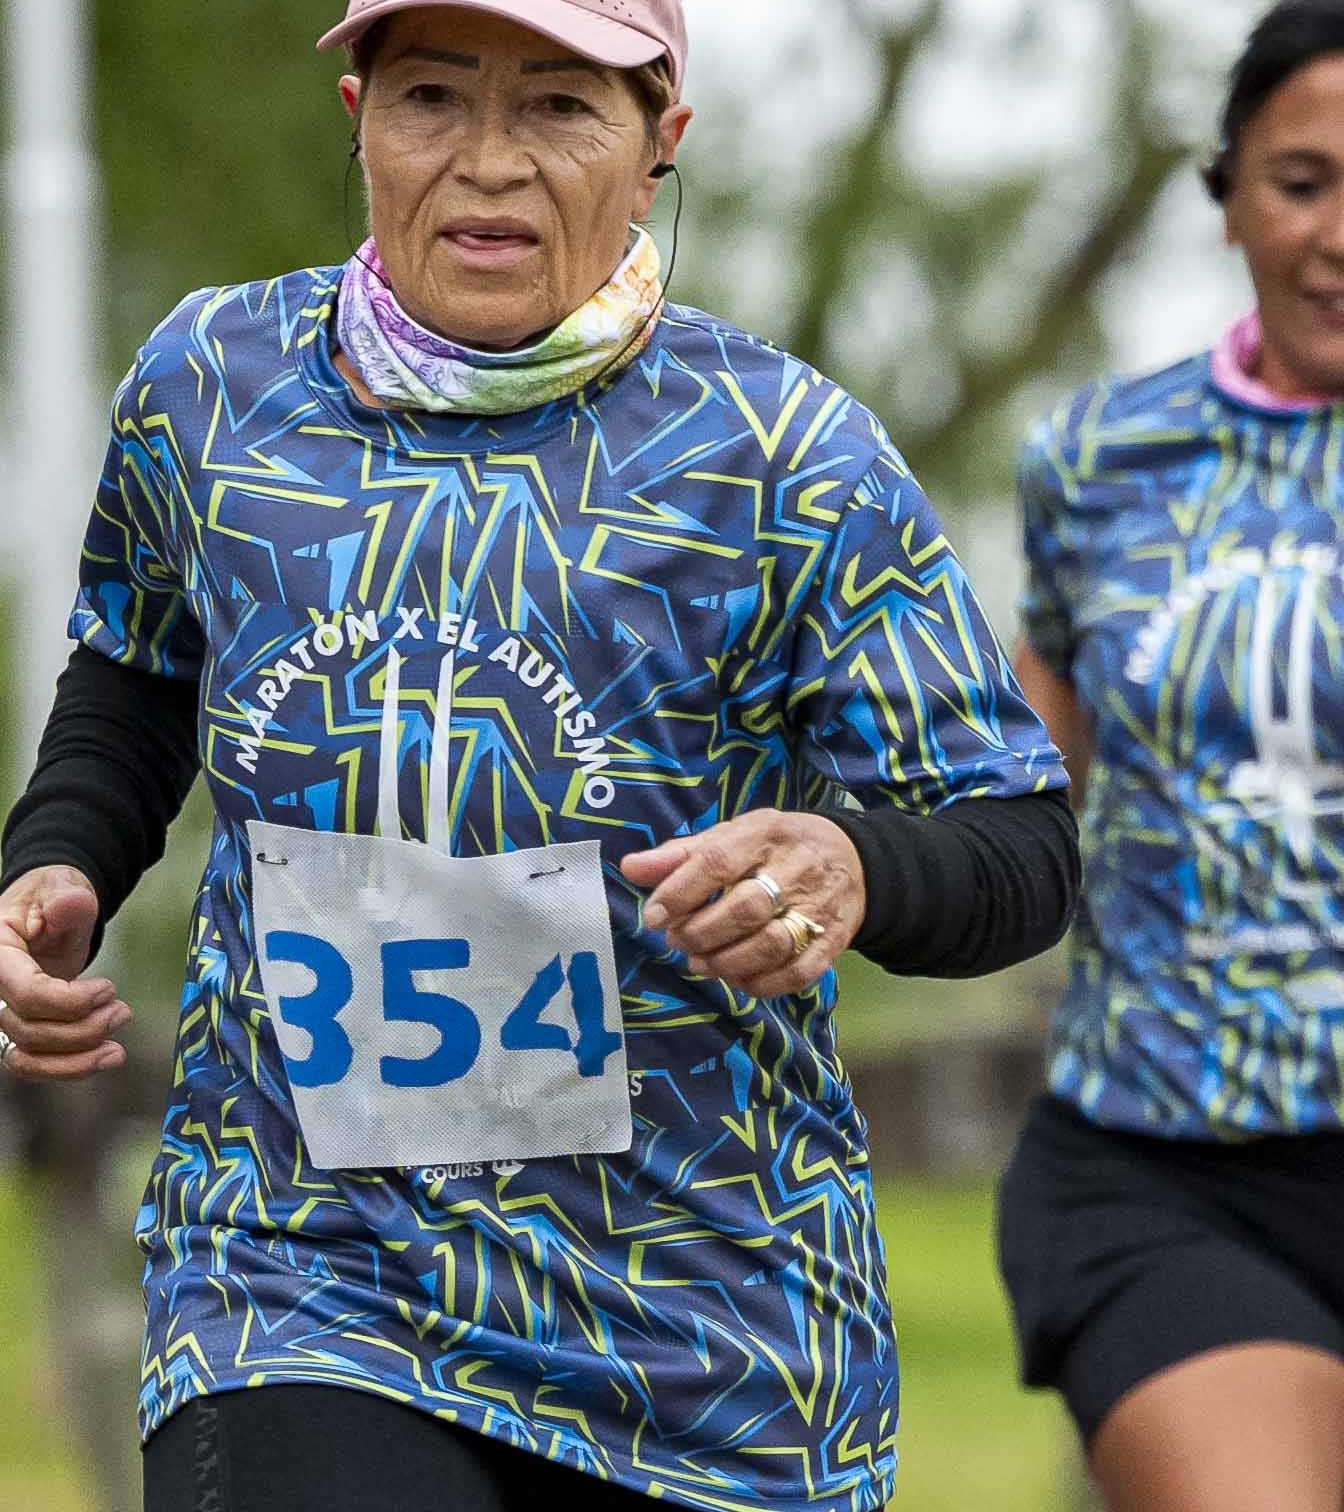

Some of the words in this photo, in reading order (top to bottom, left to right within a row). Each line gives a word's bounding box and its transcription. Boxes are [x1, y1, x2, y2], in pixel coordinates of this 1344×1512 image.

[235, 610, 380, 775] MARATÓN
[395, 607, 425, 640] X
[436, 612, 480, 653] EL
[487, 637, 616, 809] AUTISMO
[265, 930, 622, 1088] 354
